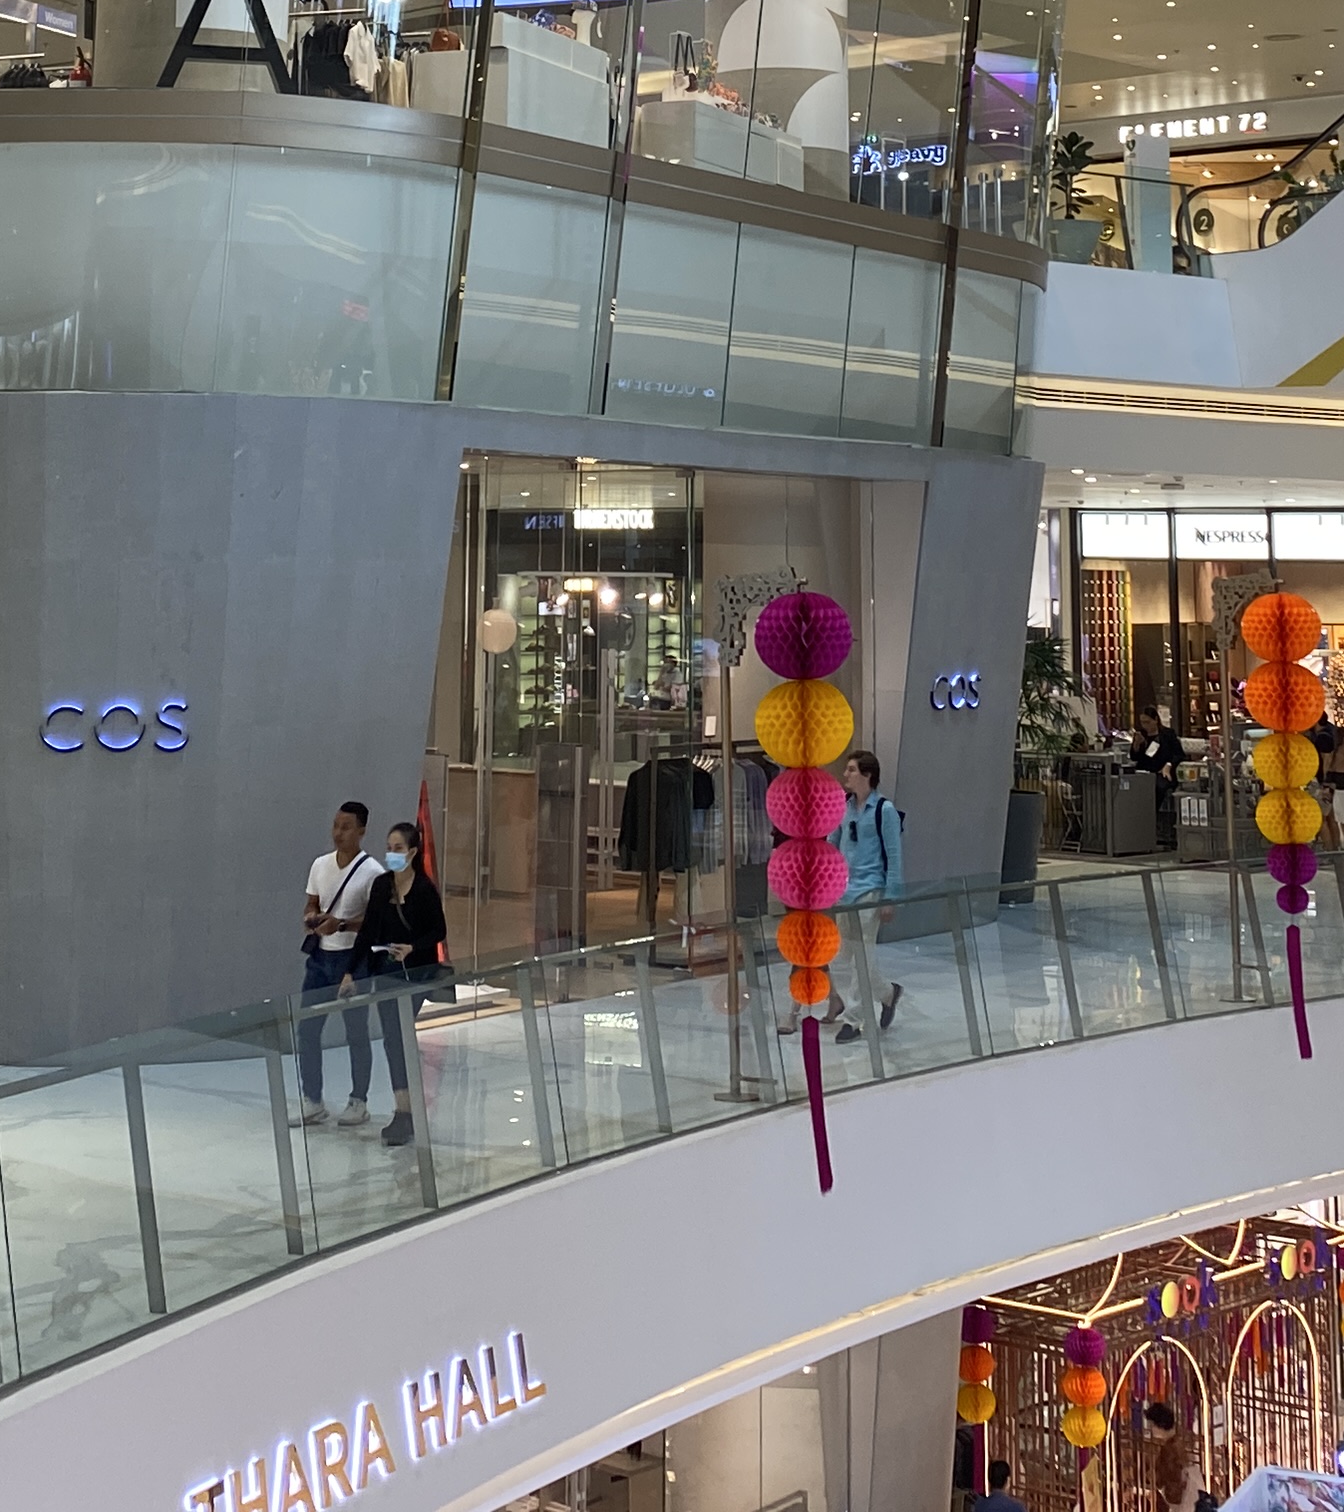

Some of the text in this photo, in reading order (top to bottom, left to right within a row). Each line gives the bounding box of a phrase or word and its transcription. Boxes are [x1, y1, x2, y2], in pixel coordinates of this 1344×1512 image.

[44, 10, 74, 30] Women
[1238, 111, 1268, 132] 72
[1198, 215, 1209, 231] 2
[1194, 527, 1270, 546] NESPRESS
[928, 673, 984, 711] COS
[38, 698, 190, 753] COS
[184, 1330, 547, 1512] THARA HALL
